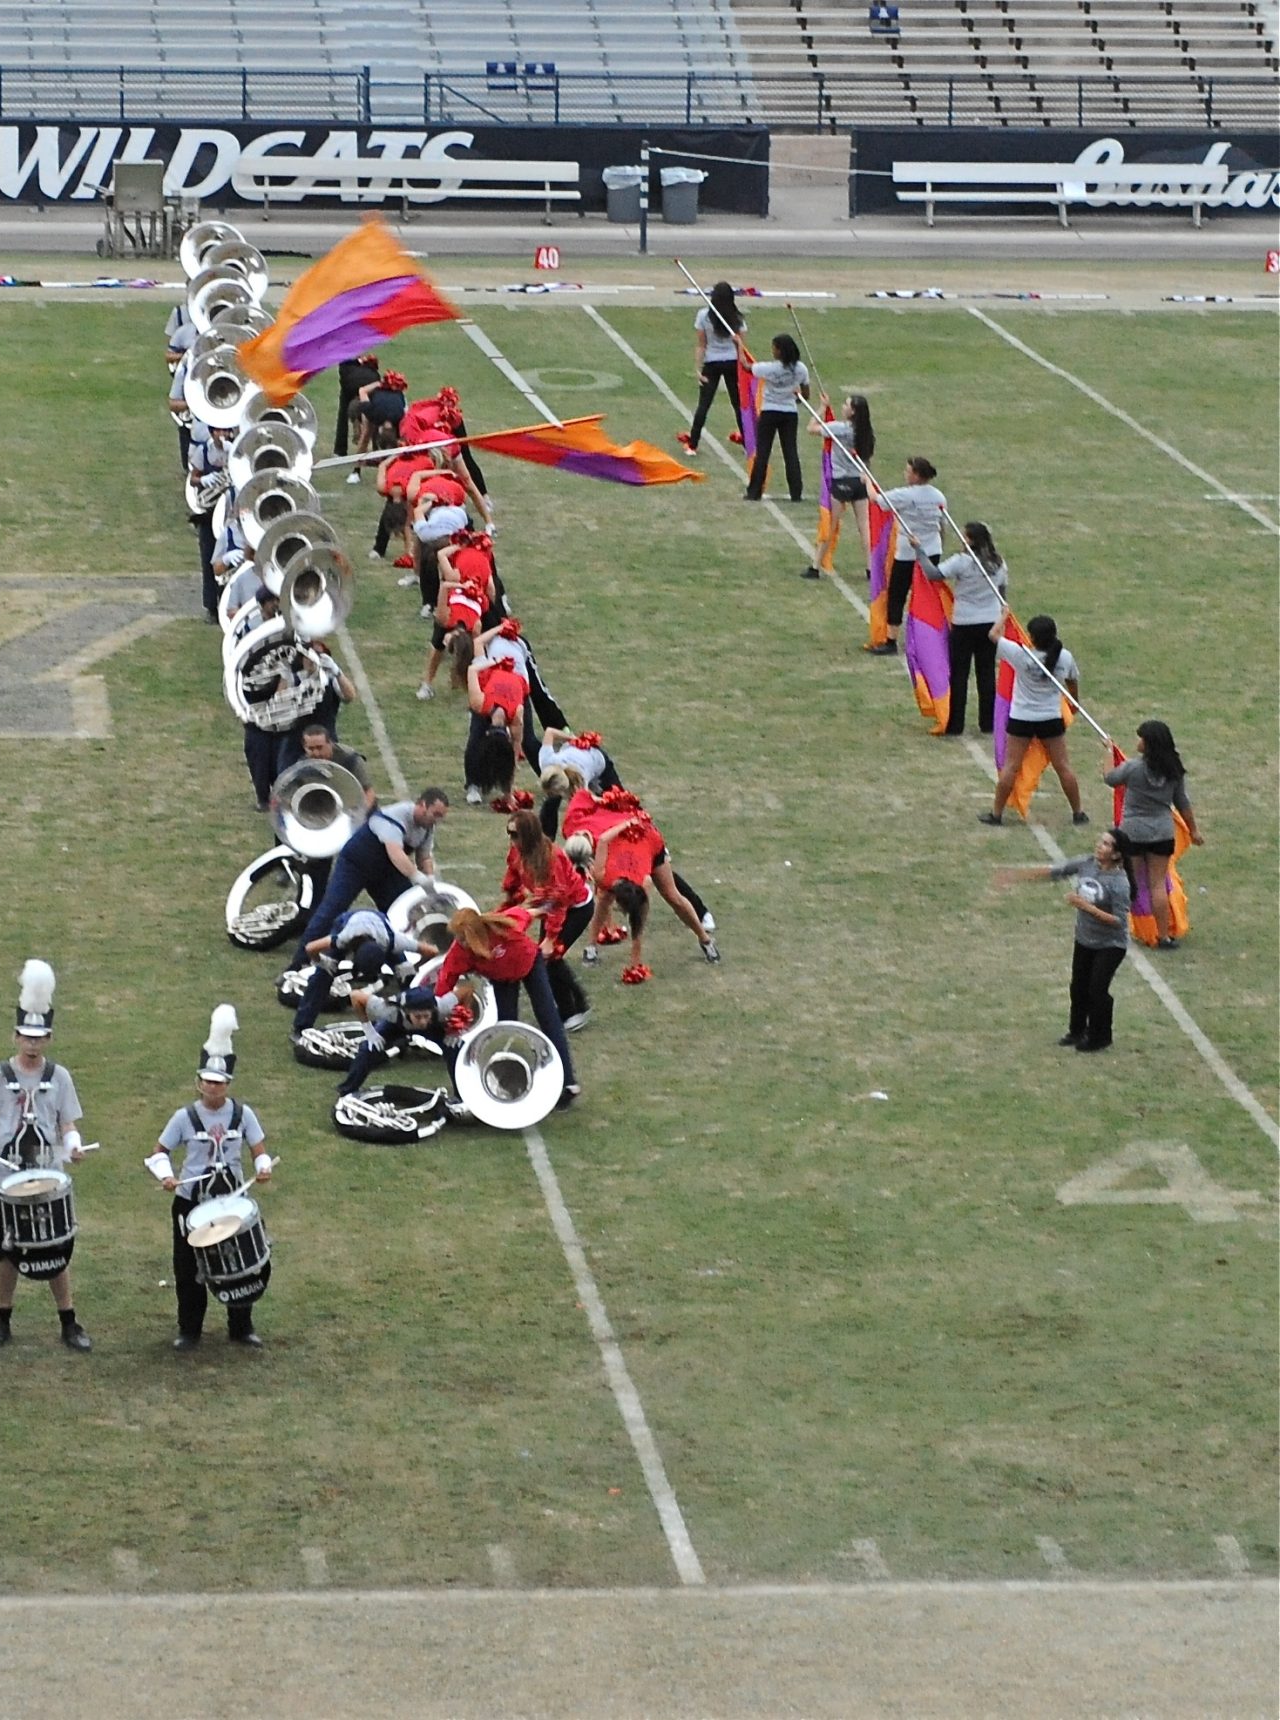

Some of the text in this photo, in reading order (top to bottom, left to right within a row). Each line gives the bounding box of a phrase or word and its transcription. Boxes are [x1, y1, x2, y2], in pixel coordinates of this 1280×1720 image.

[539, 247, 558, 268] 40
[30, 1256, 66, 1272] YAMAHA
[229, 1280, 264, 1300] YAMAHA
